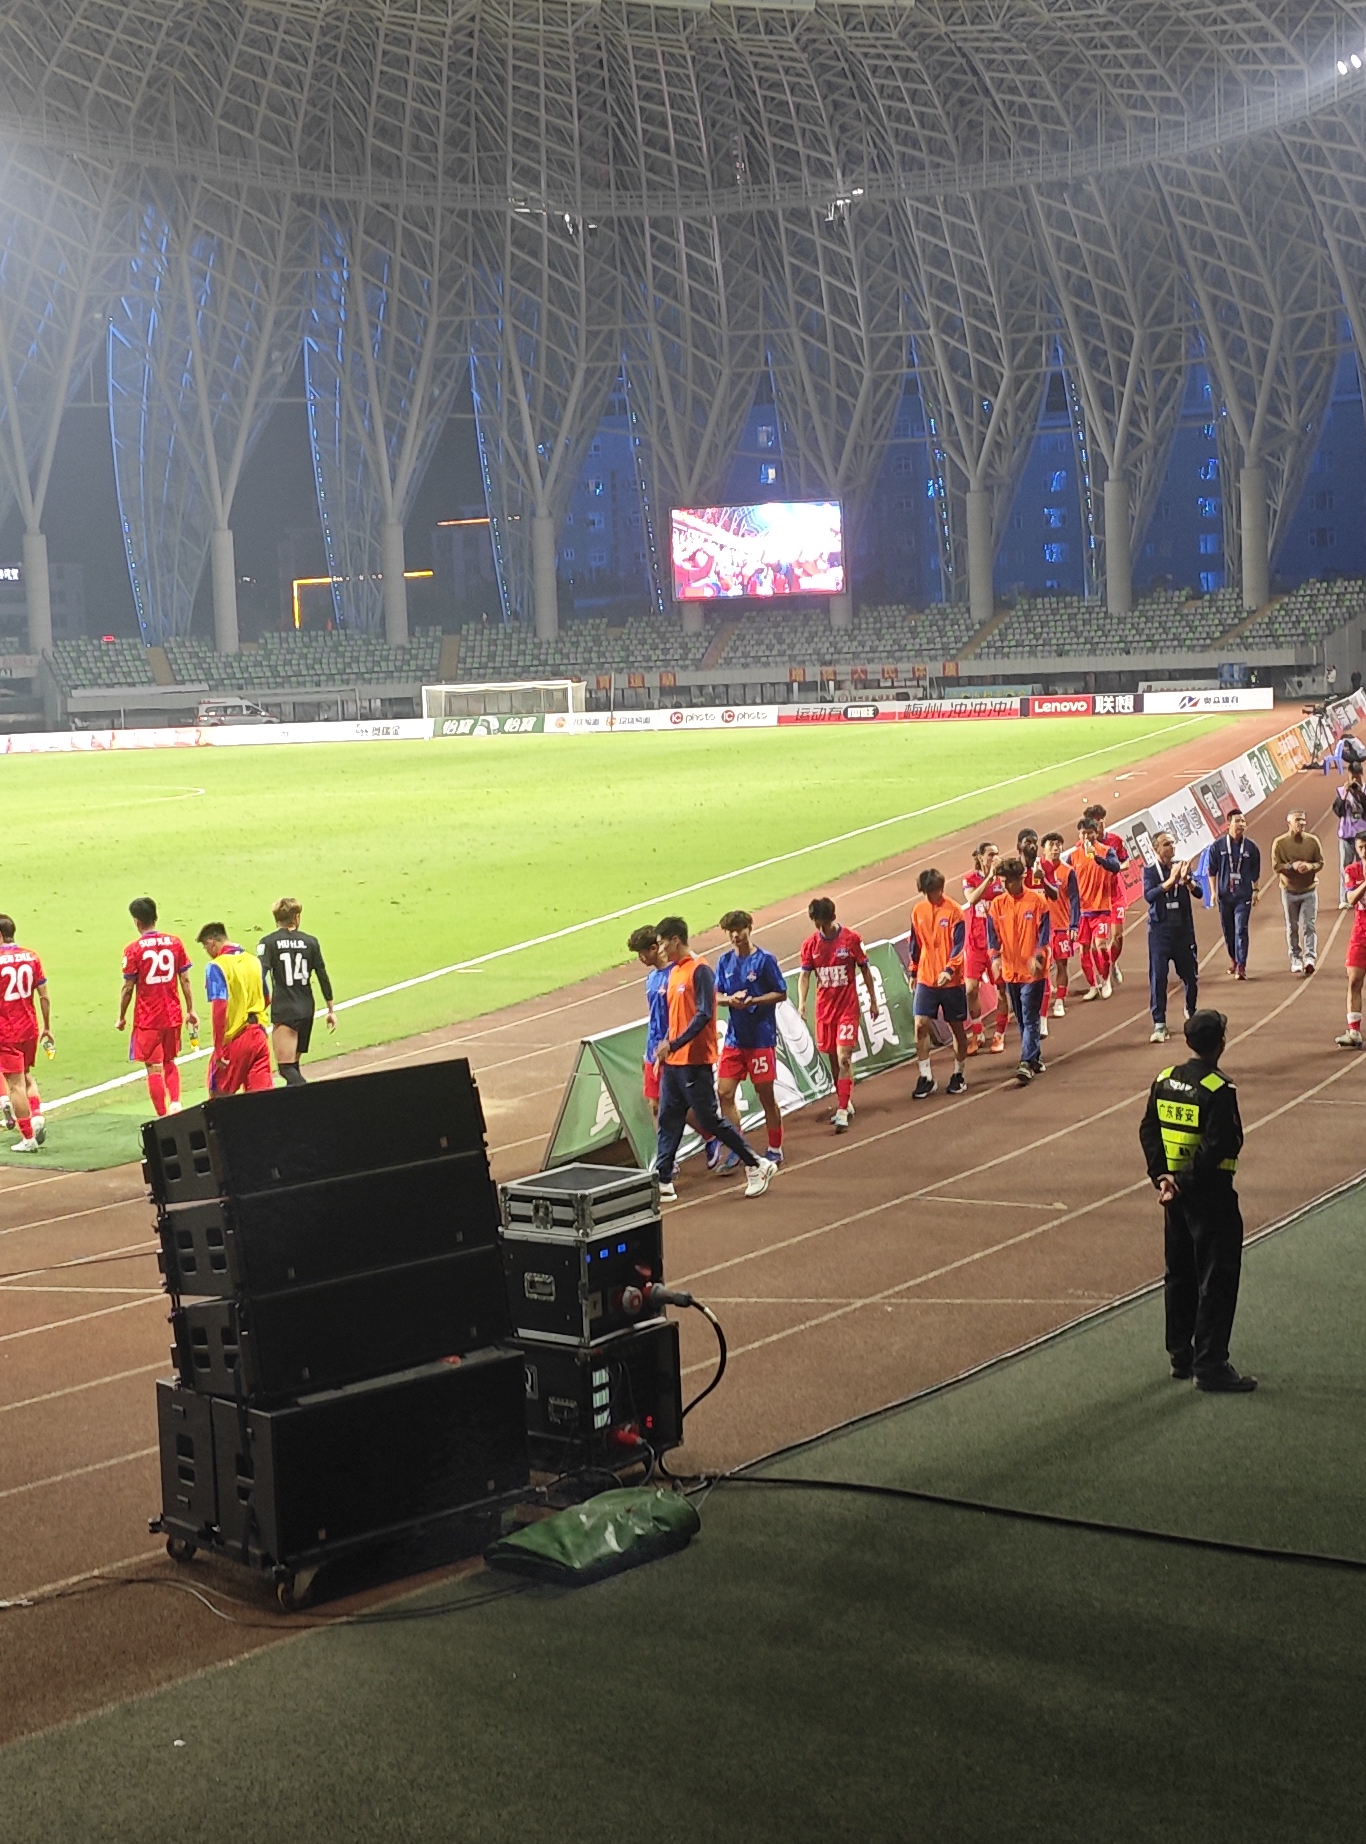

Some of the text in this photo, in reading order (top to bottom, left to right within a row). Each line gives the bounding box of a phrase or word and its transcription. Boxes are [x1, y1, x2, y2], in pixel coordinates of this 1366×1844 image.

[1034, 700, 1087, 713] Lenovo
[1095, 695, 1134, 714] 联想
[1098, 922, 1108, 934] 31
[142, 948, 175, 985] 29
[279, 952, 309, 987] 14
[1, 963, 34, 1001] 20
[839, 1024, 854, 1040] 22
[751, 1055, 769, 1075] 25
